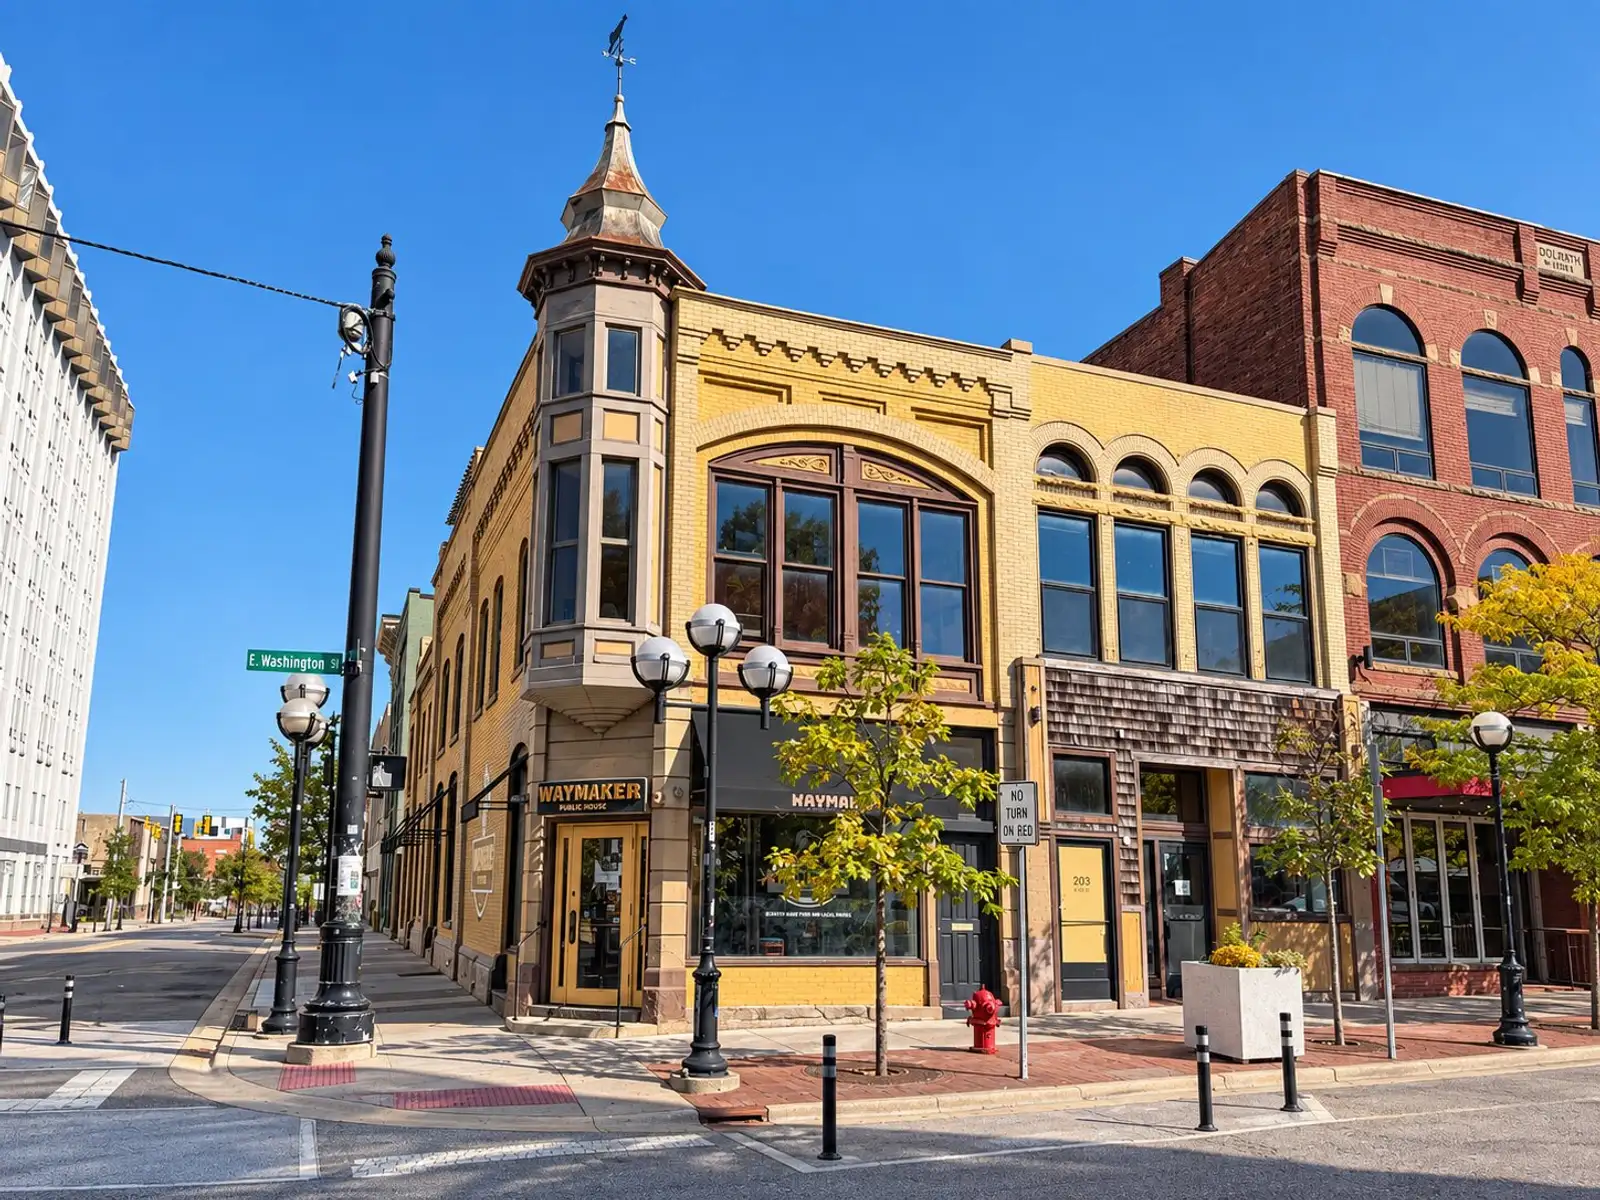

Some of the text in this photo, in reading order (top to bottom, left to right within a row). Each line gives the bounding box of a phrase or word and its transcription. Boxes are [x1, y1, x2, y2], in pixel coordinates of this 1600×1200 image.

[249, 653, 259, 667] E.
[261, 654, 325, 672] Washington
[539, 782, 641, 802] WAYMAKER
[1011, 789, 1024, 801] NO
[559, 802, 607, 812] PUBLIC HOUSE
[792, 793, 859, 809] WAYMAK
[1006, 807, 1028, 819] TURN
[1003, 825, 1033, 837] ON RED
[1073, 876, 1091, 887] 203
